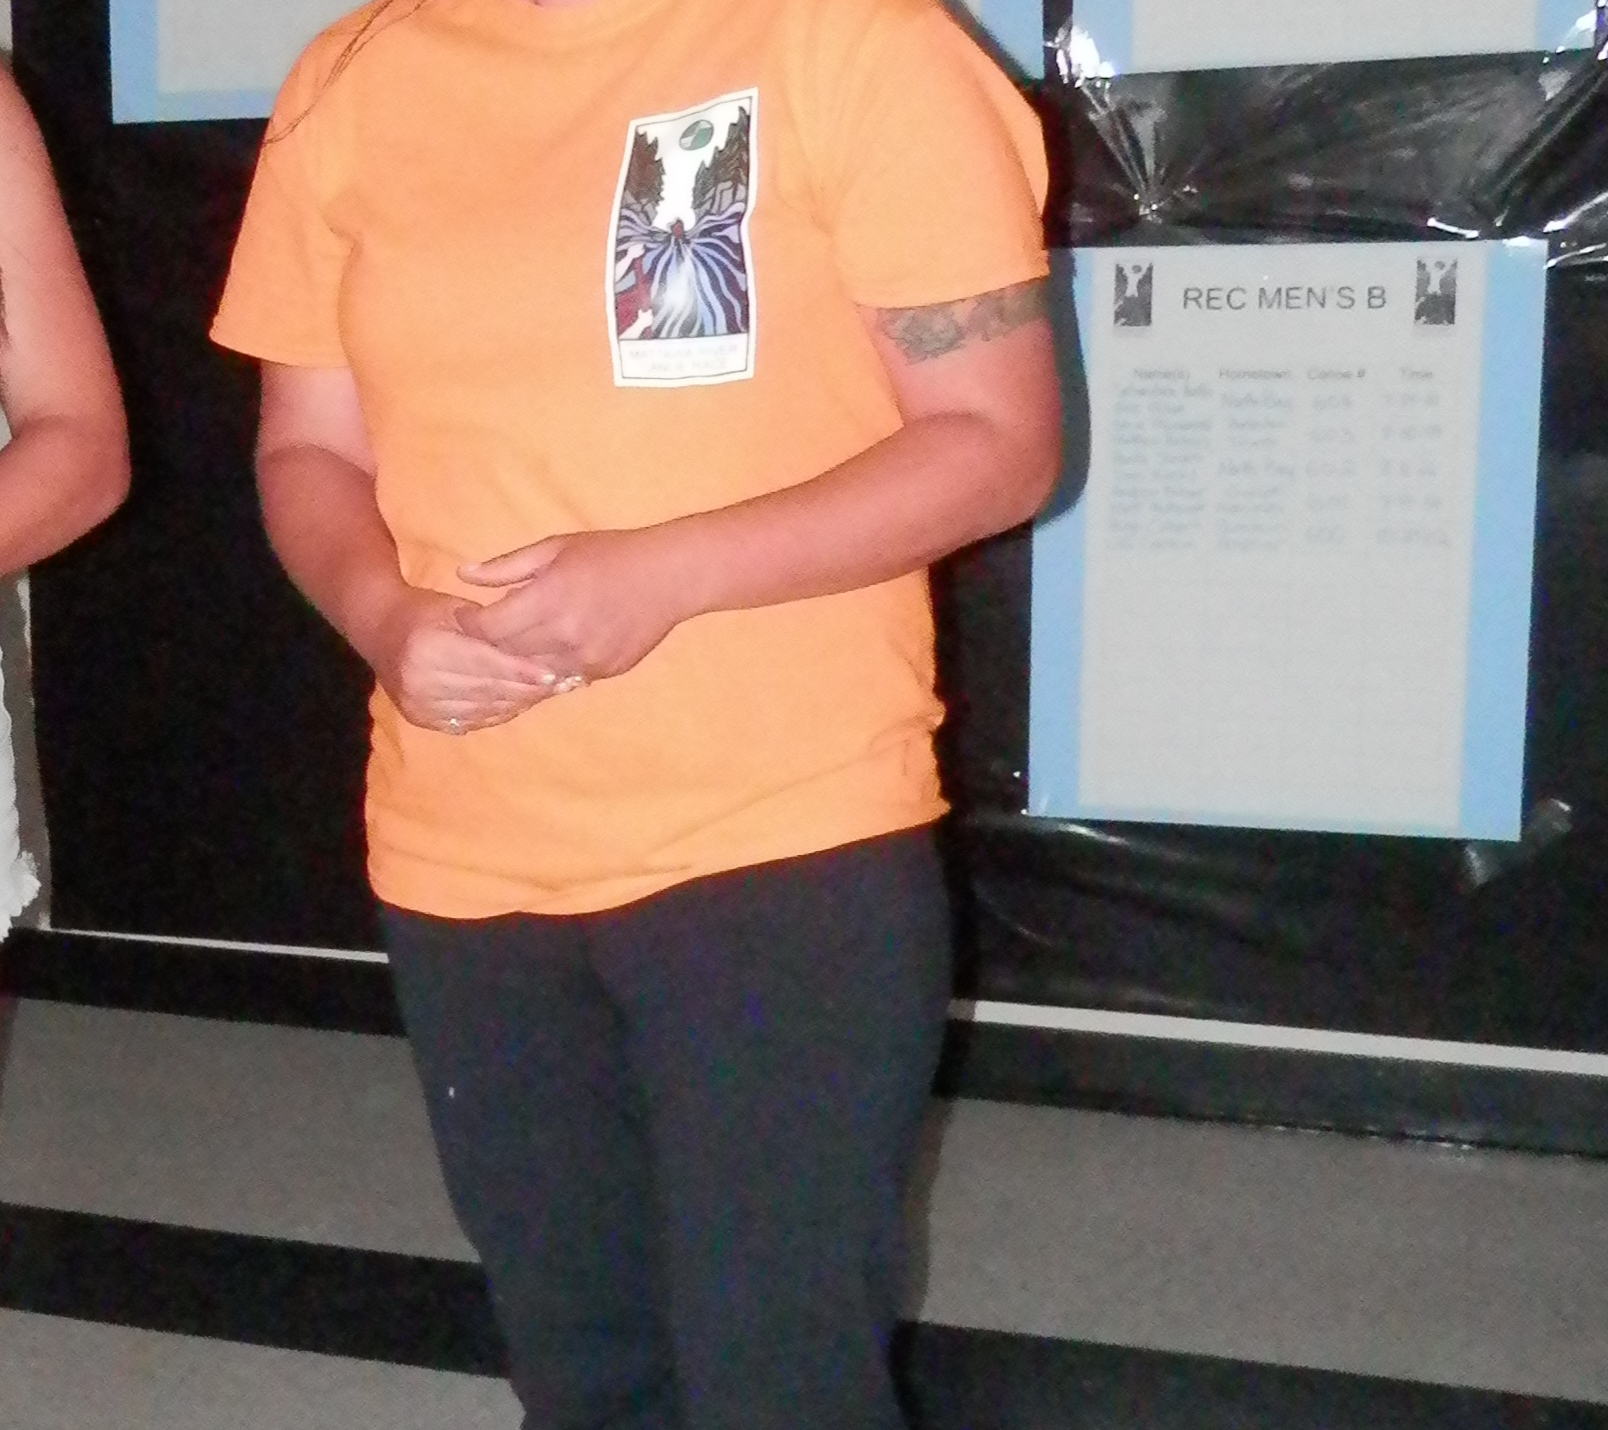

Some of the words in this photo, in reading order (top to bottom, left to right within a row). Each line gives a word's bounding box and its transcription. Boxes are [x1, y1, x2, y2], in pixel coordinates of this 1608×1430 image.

[1183, 287, 1247, 310] REC
[1258, 285, 1355, 309] MEN'S
[1367, 286, 1387, 309] B
